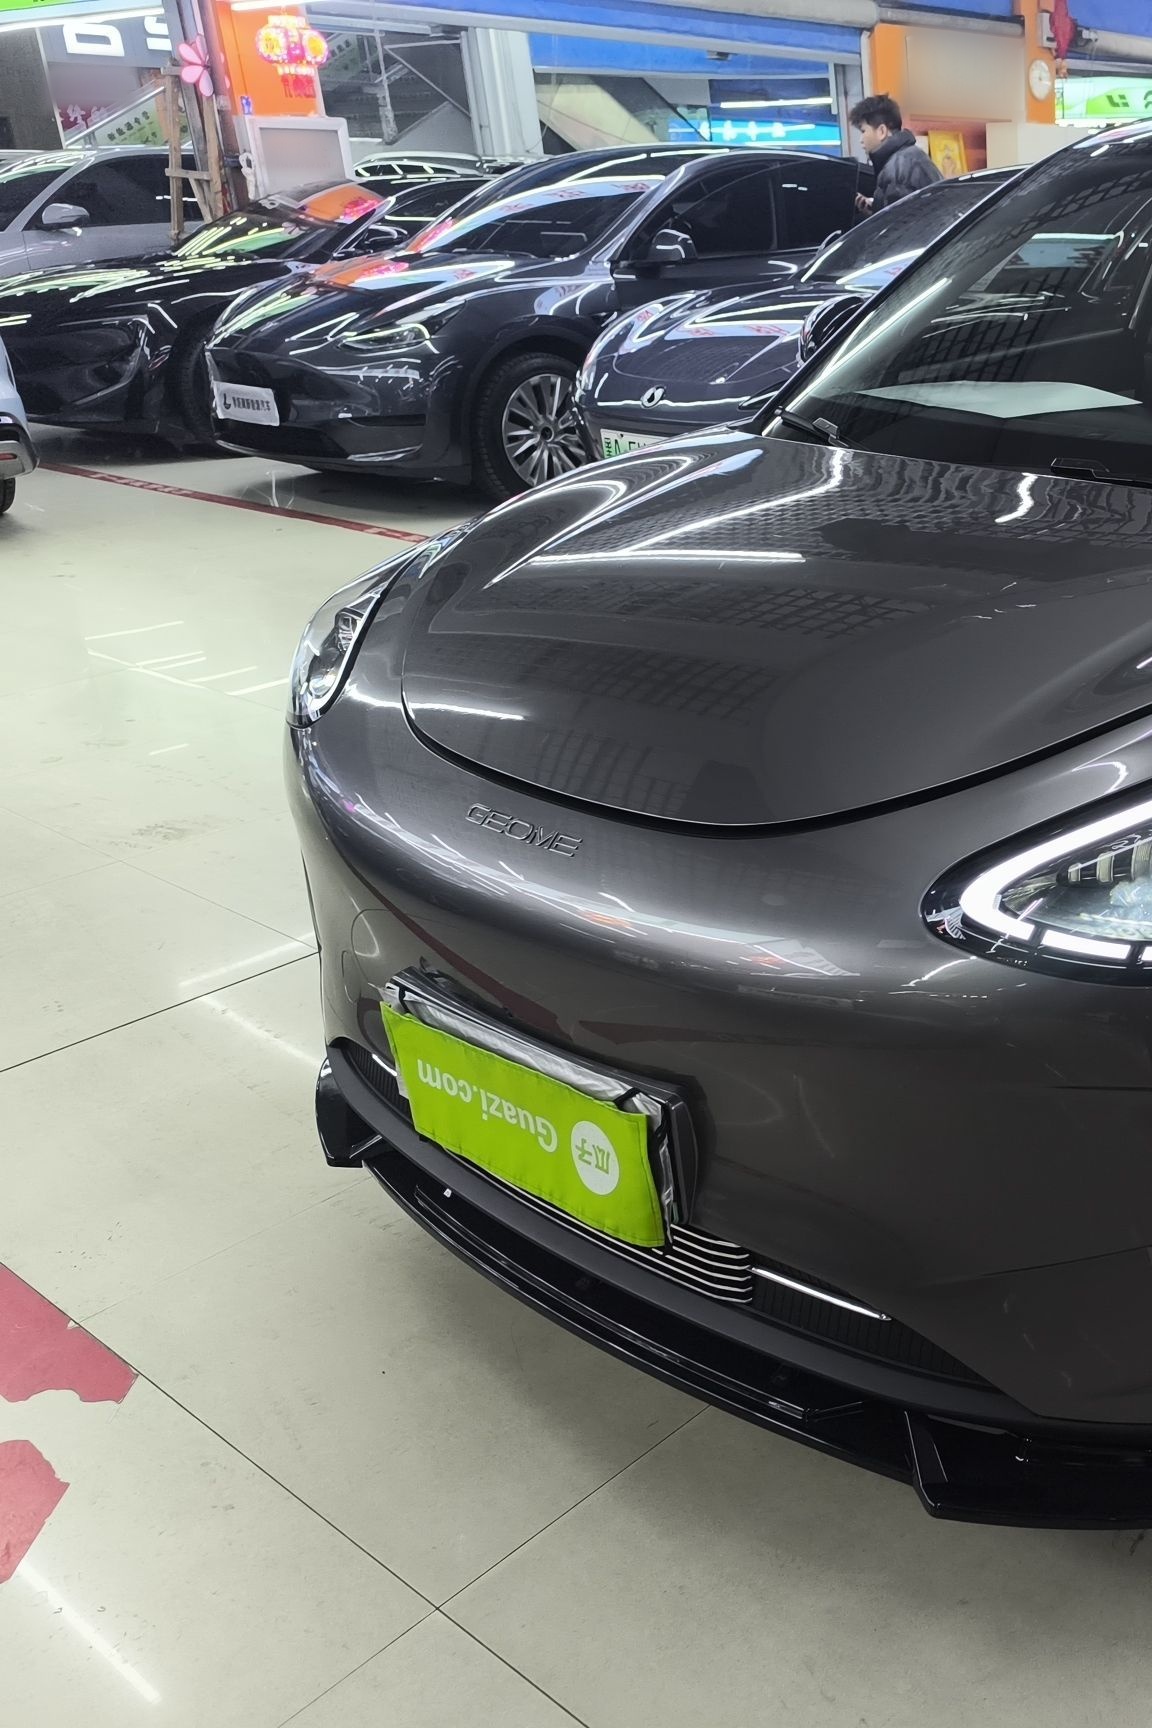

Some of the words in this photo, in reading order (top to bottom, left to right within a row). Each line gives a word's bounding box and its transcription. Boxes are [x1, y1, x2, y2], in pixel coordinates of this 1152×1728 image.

[465, 802, 584, 858] GEOME
[417, 1058, 558, 1153] Guazi.com
[575, 1137, 611, 1176] 瓜子
